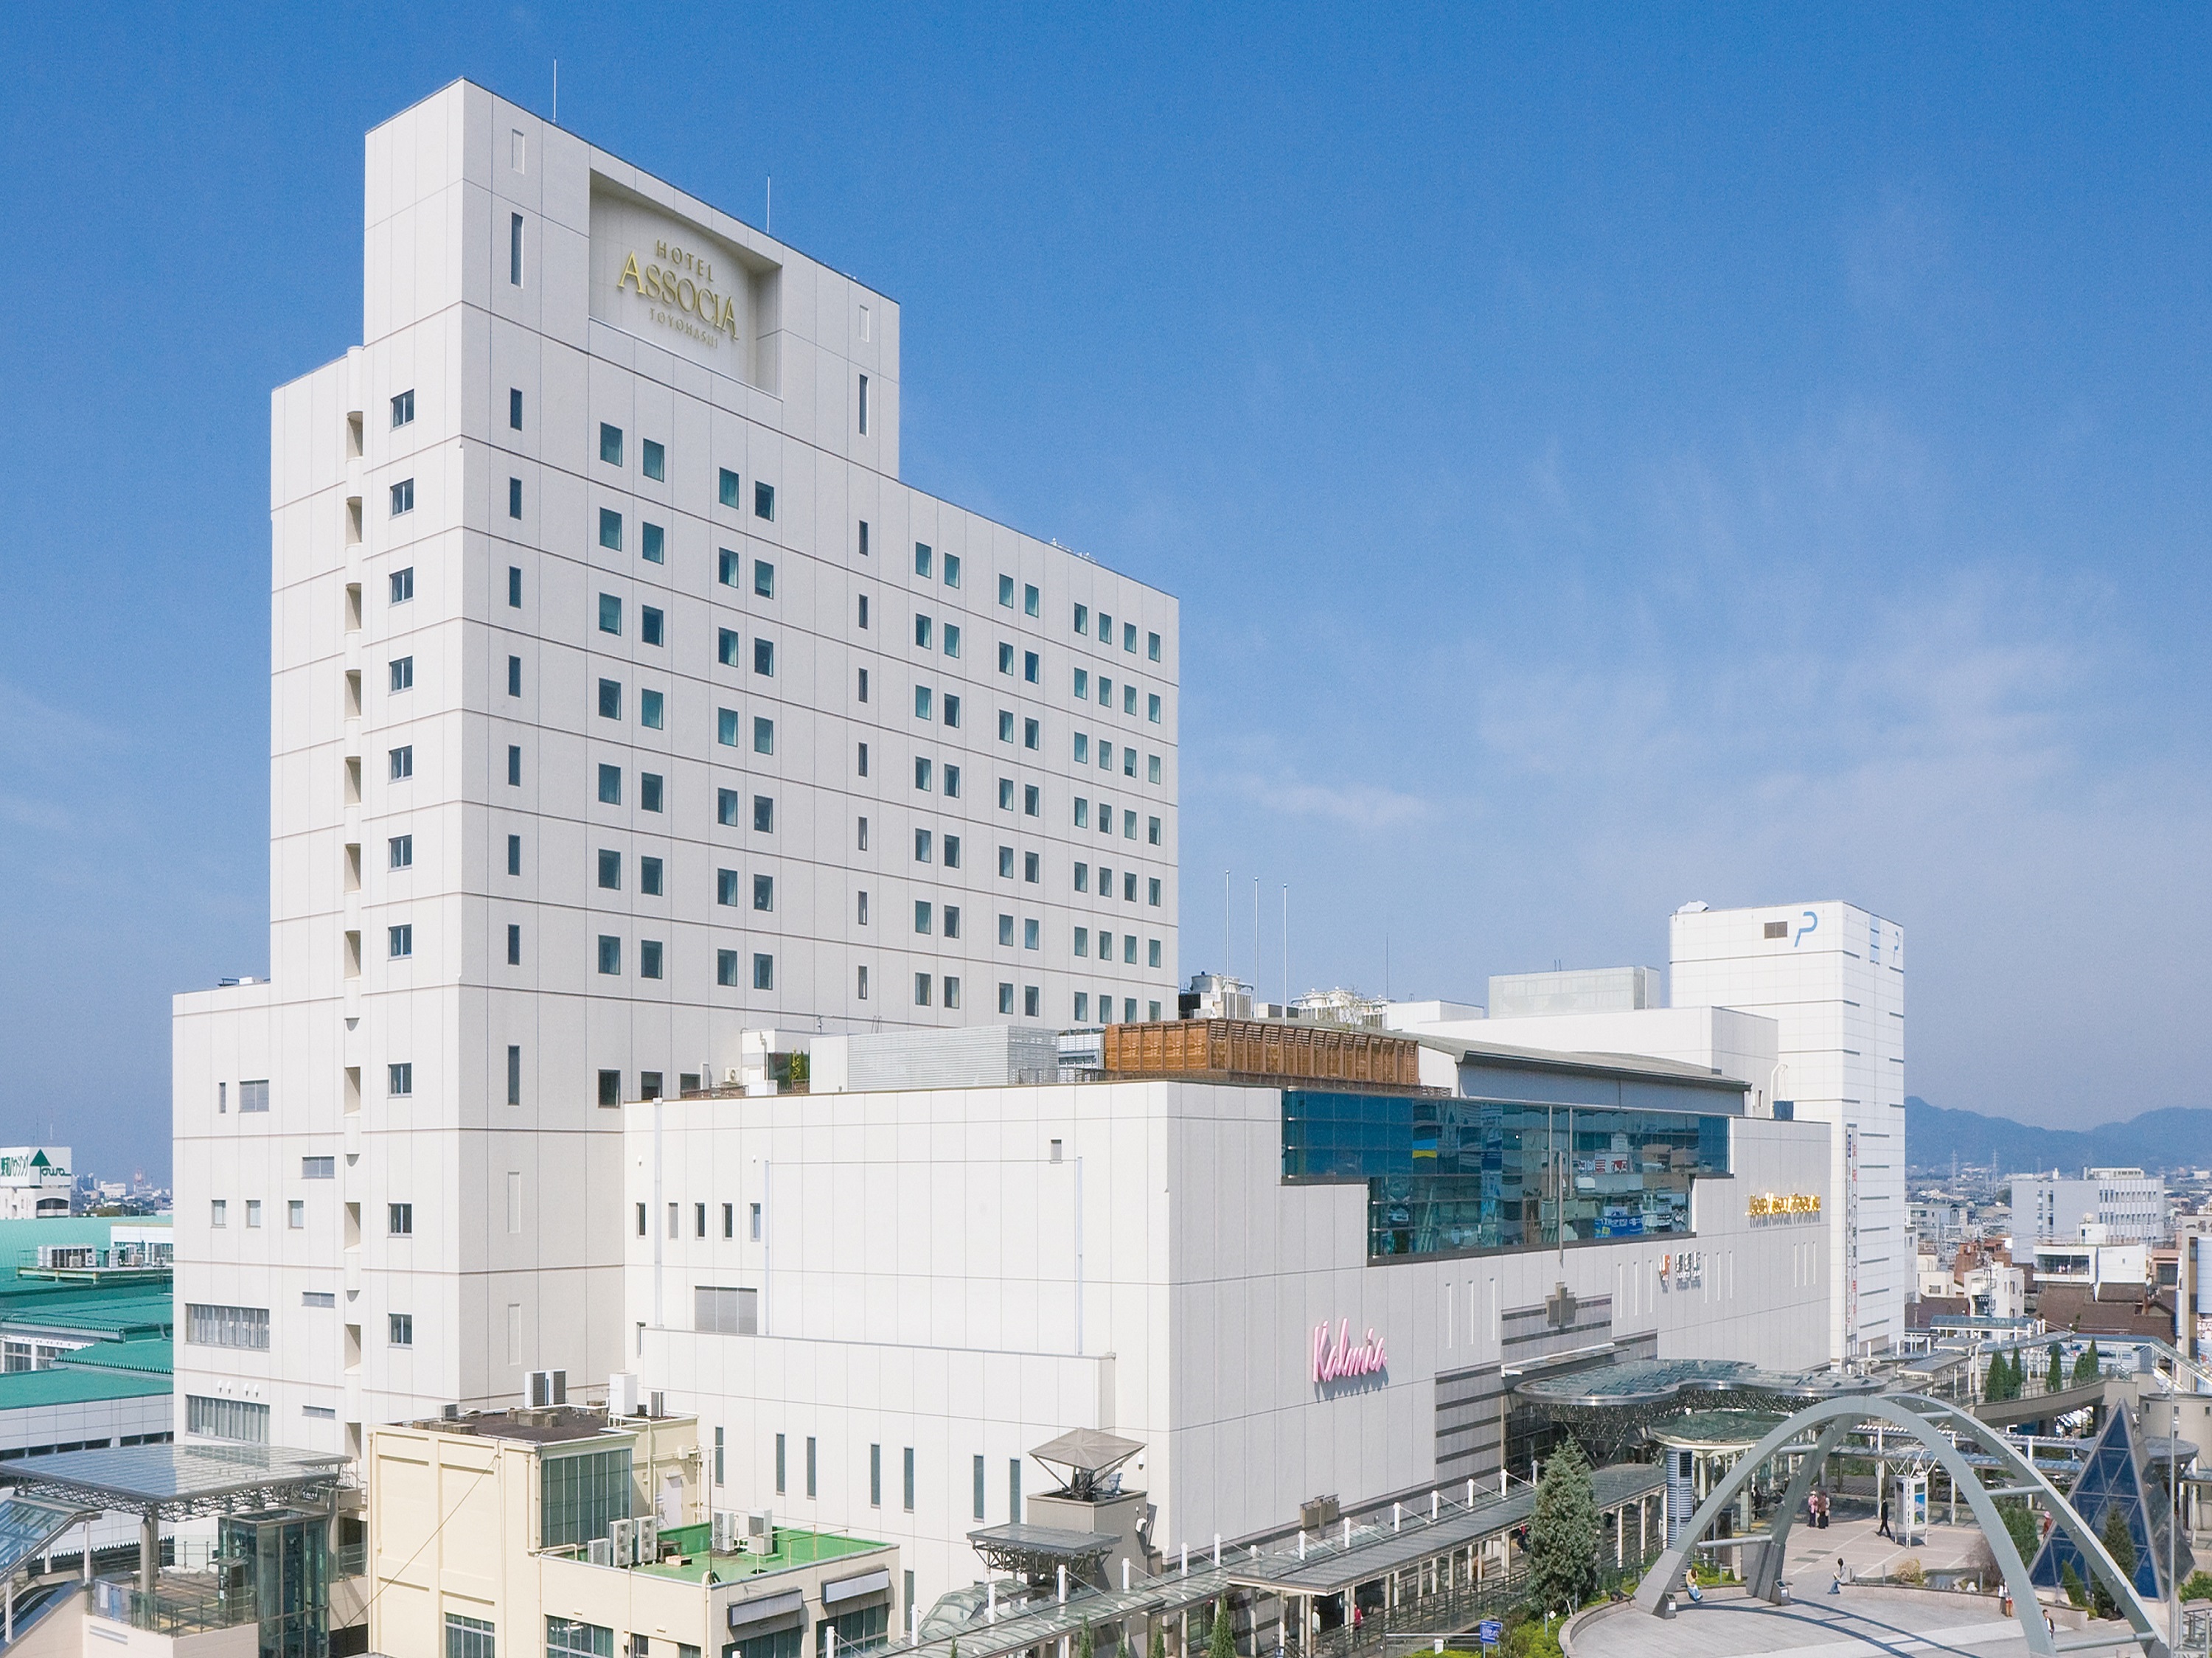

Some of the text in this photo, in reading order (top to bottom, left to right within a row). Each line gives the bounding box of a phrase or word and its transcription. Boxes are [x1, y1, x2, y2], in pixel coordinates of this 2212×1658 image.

[656, 239, 714, 282] HOTEL
[617, 250, 739, 341] ASSOCIA
[650, 307, 718, 349] TOYOHASHI
[1312, 1317, 1388, 1383] Kalmia
